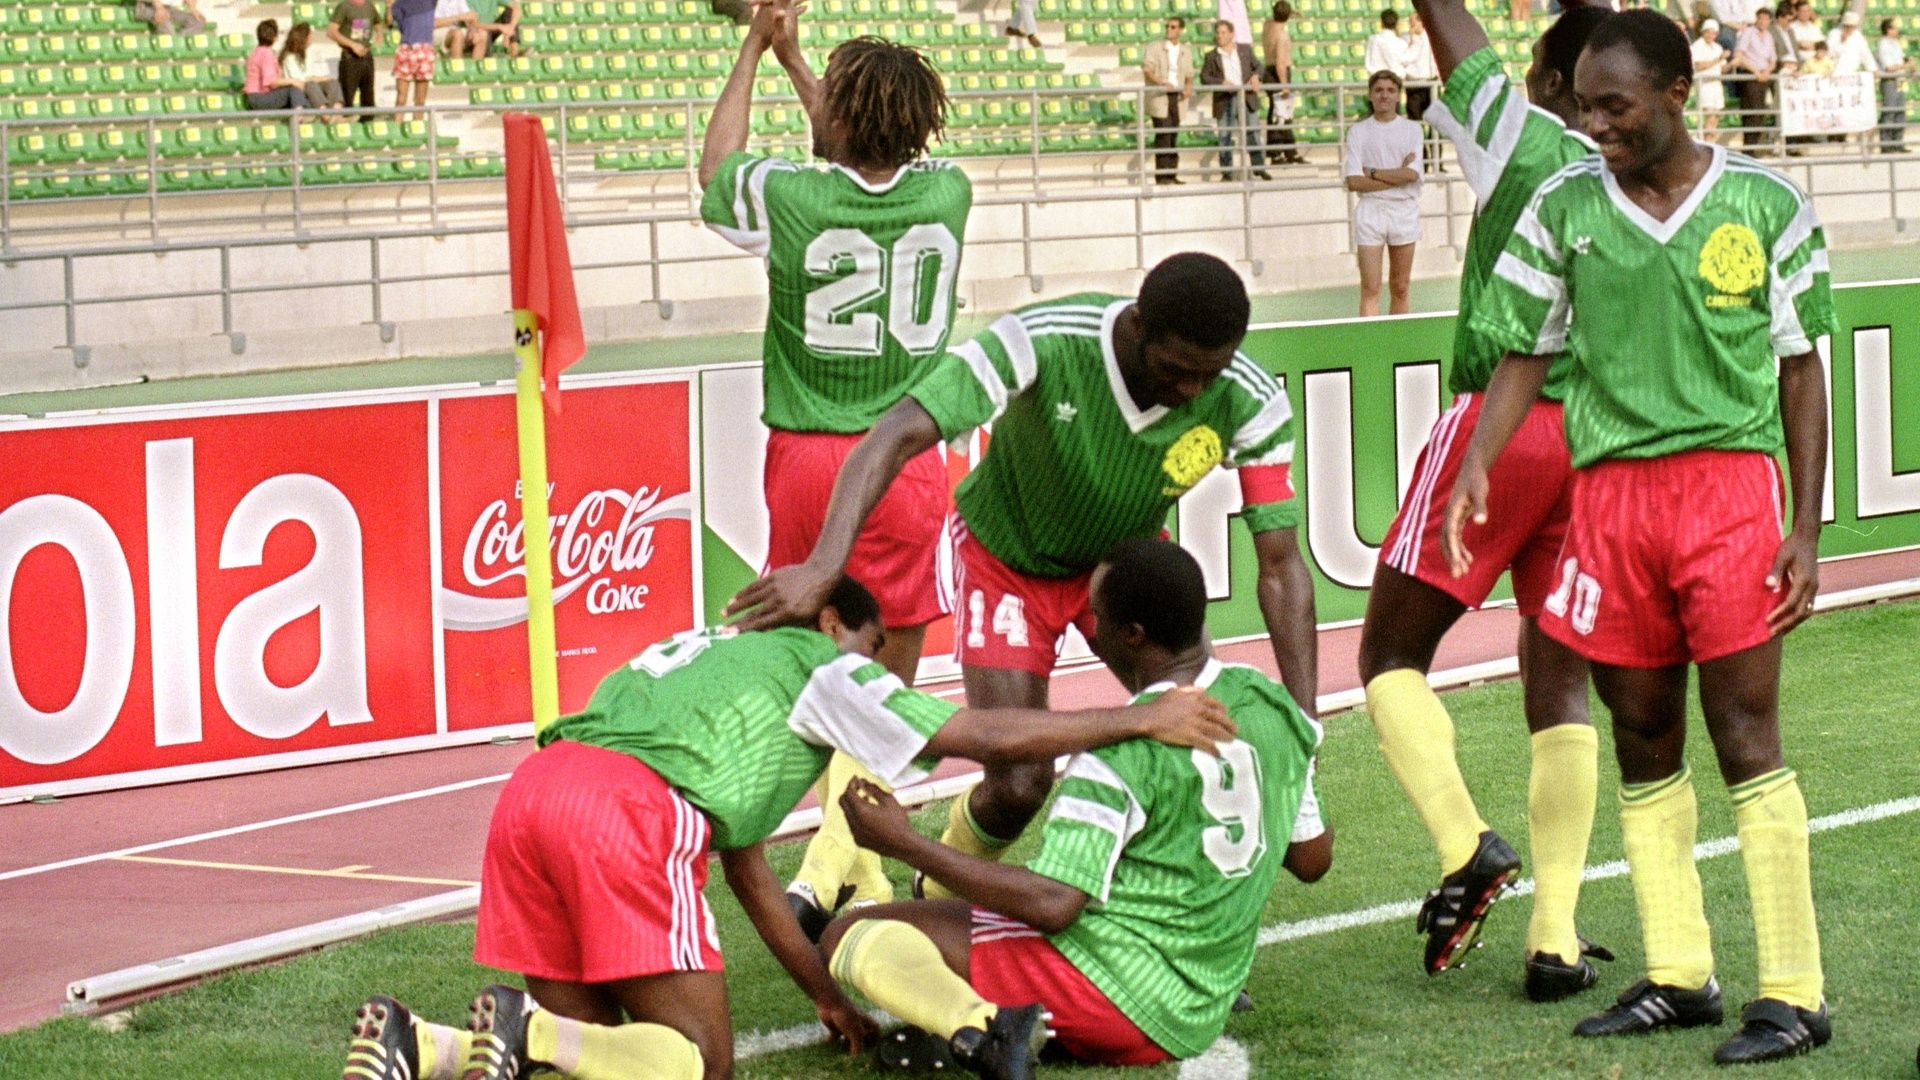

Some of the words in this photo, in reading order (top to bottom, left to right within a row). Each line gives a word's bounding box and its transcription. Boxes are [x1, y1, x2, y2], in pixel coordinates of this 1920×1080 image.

[804, 223, 958, 356] 20
[463, 485, 661, 587] Coc-Cola
[0, 437, 374, 765] ola
[586, 577, 649, 615] Coke
[967, 589, 1029, 648] 14
[1545, 556, 1602, 636] 10
[1191, 738, 1267, 879] 9
